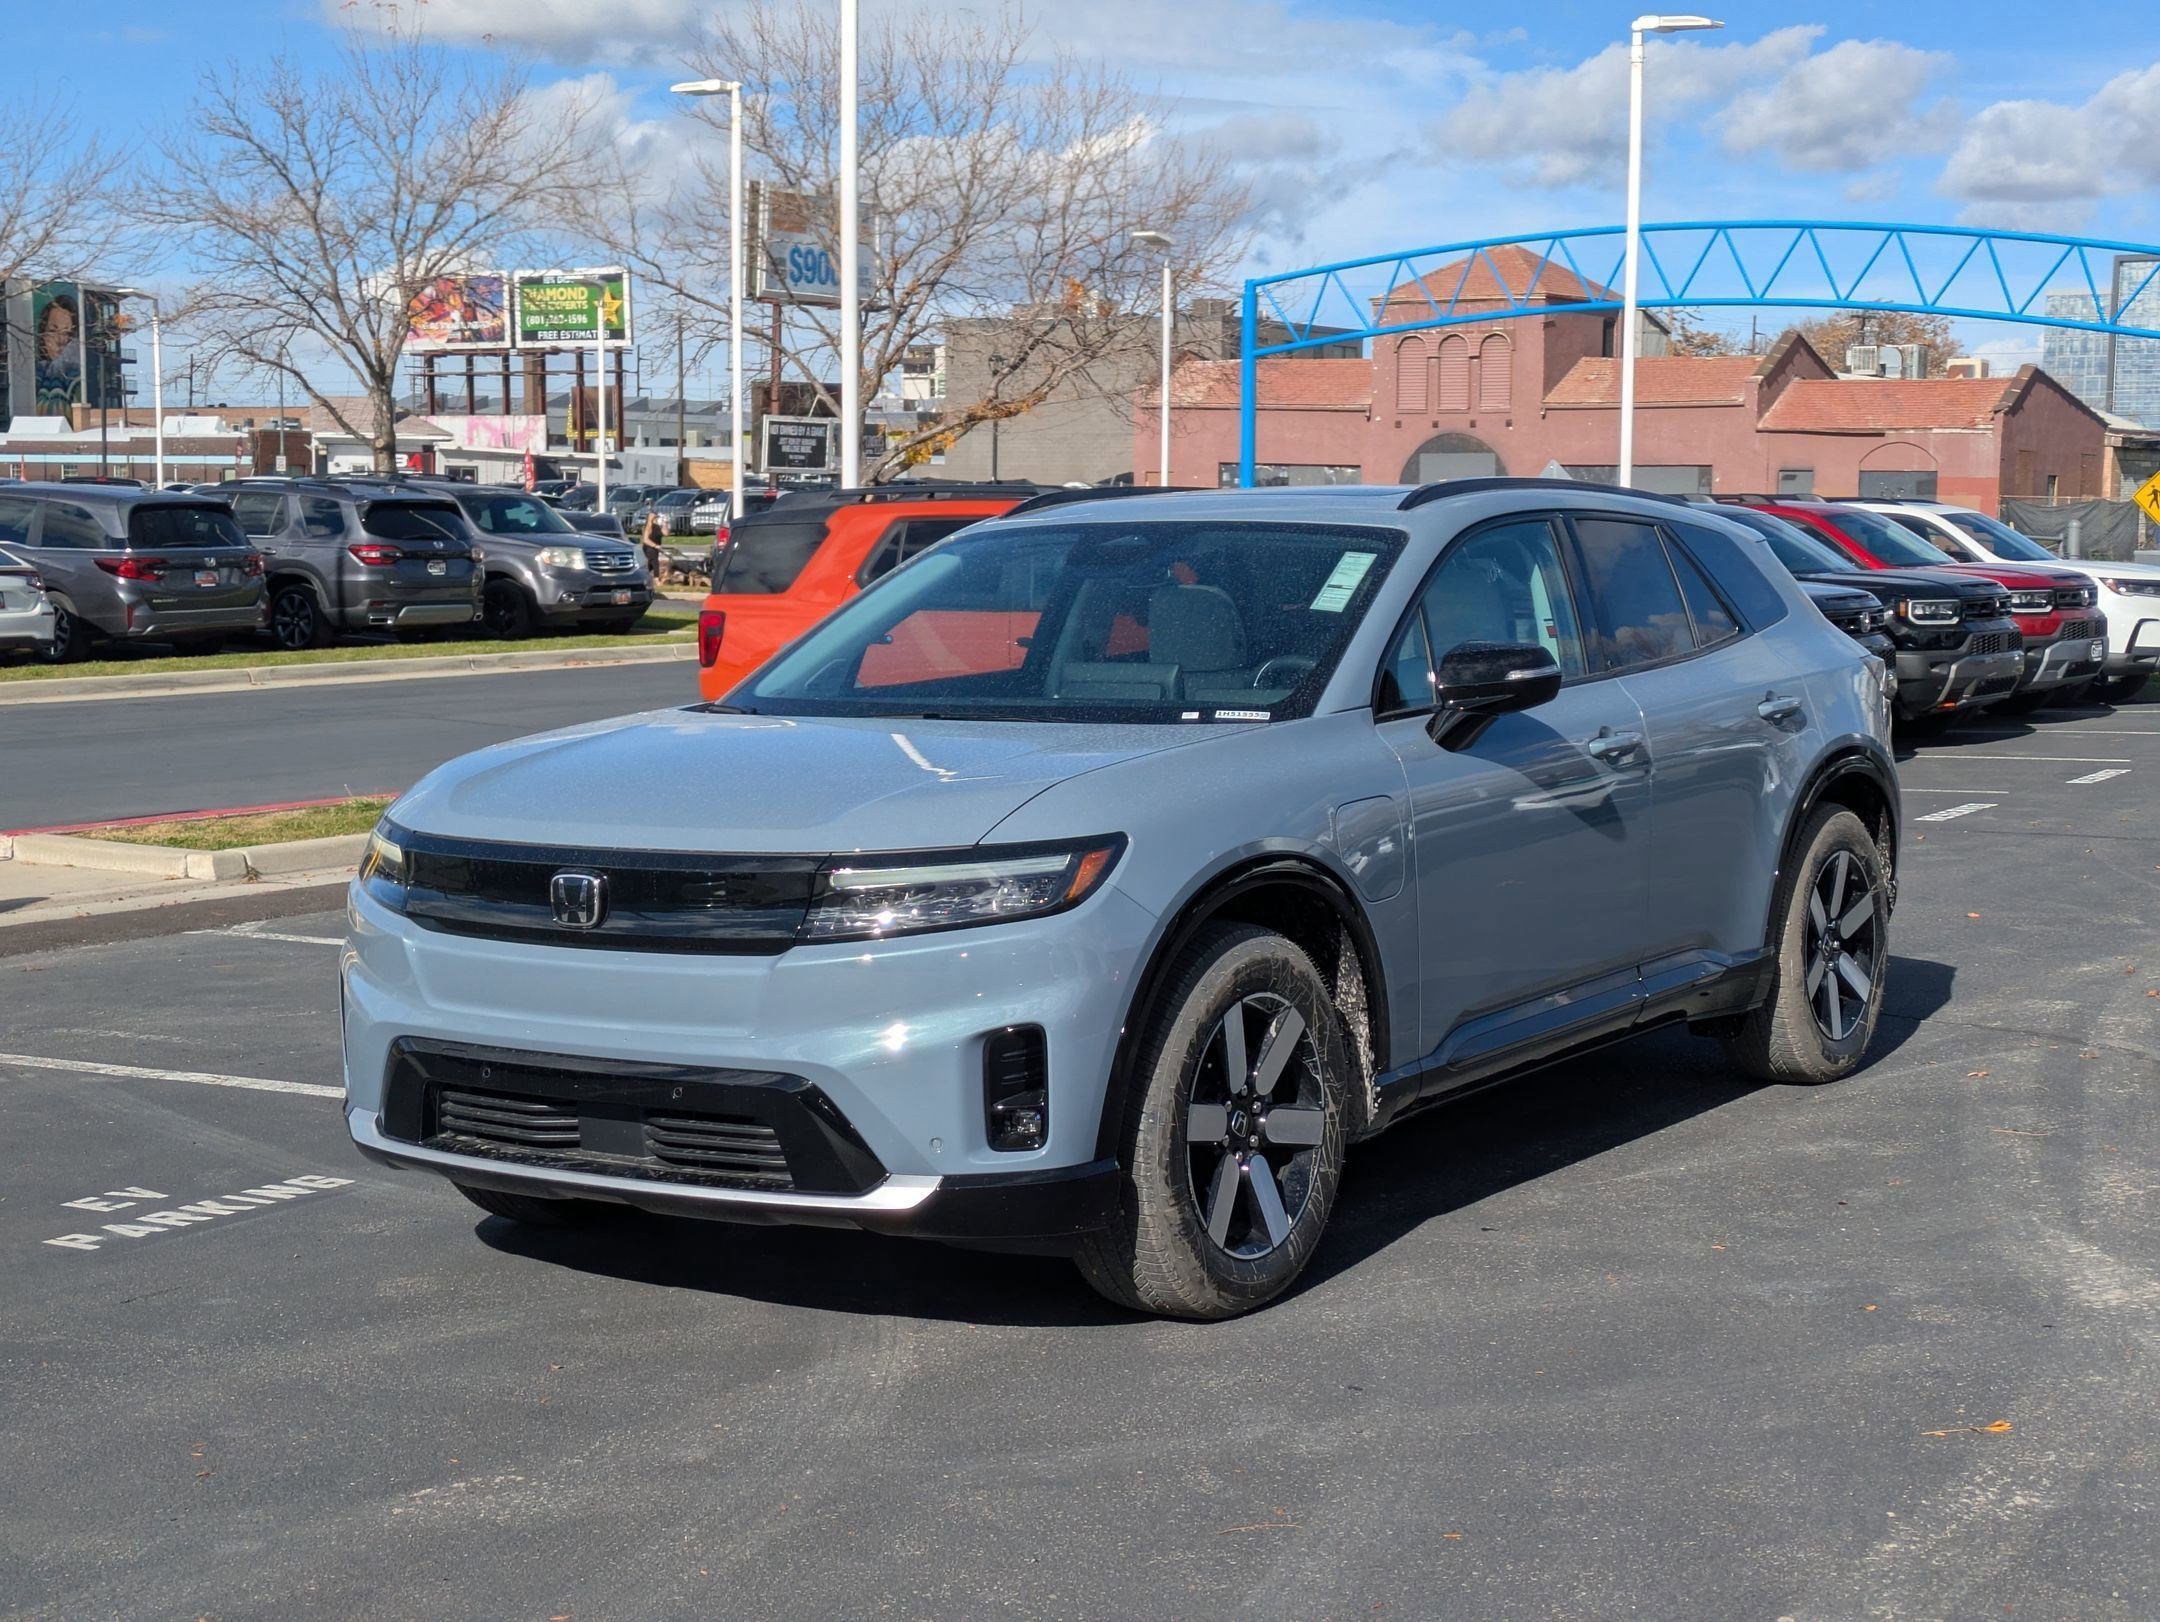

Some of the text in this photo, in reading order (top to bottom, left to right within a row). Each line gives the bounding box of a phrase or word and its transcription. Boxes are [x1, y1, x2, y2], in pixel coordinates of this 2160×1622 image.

[523, 286, 588, 302] DIAMOND
[537, 331, 559, 340] FREE
[60, 1186, 169, 1213] EV
[41, 1174, 356, 1251] PARKING
